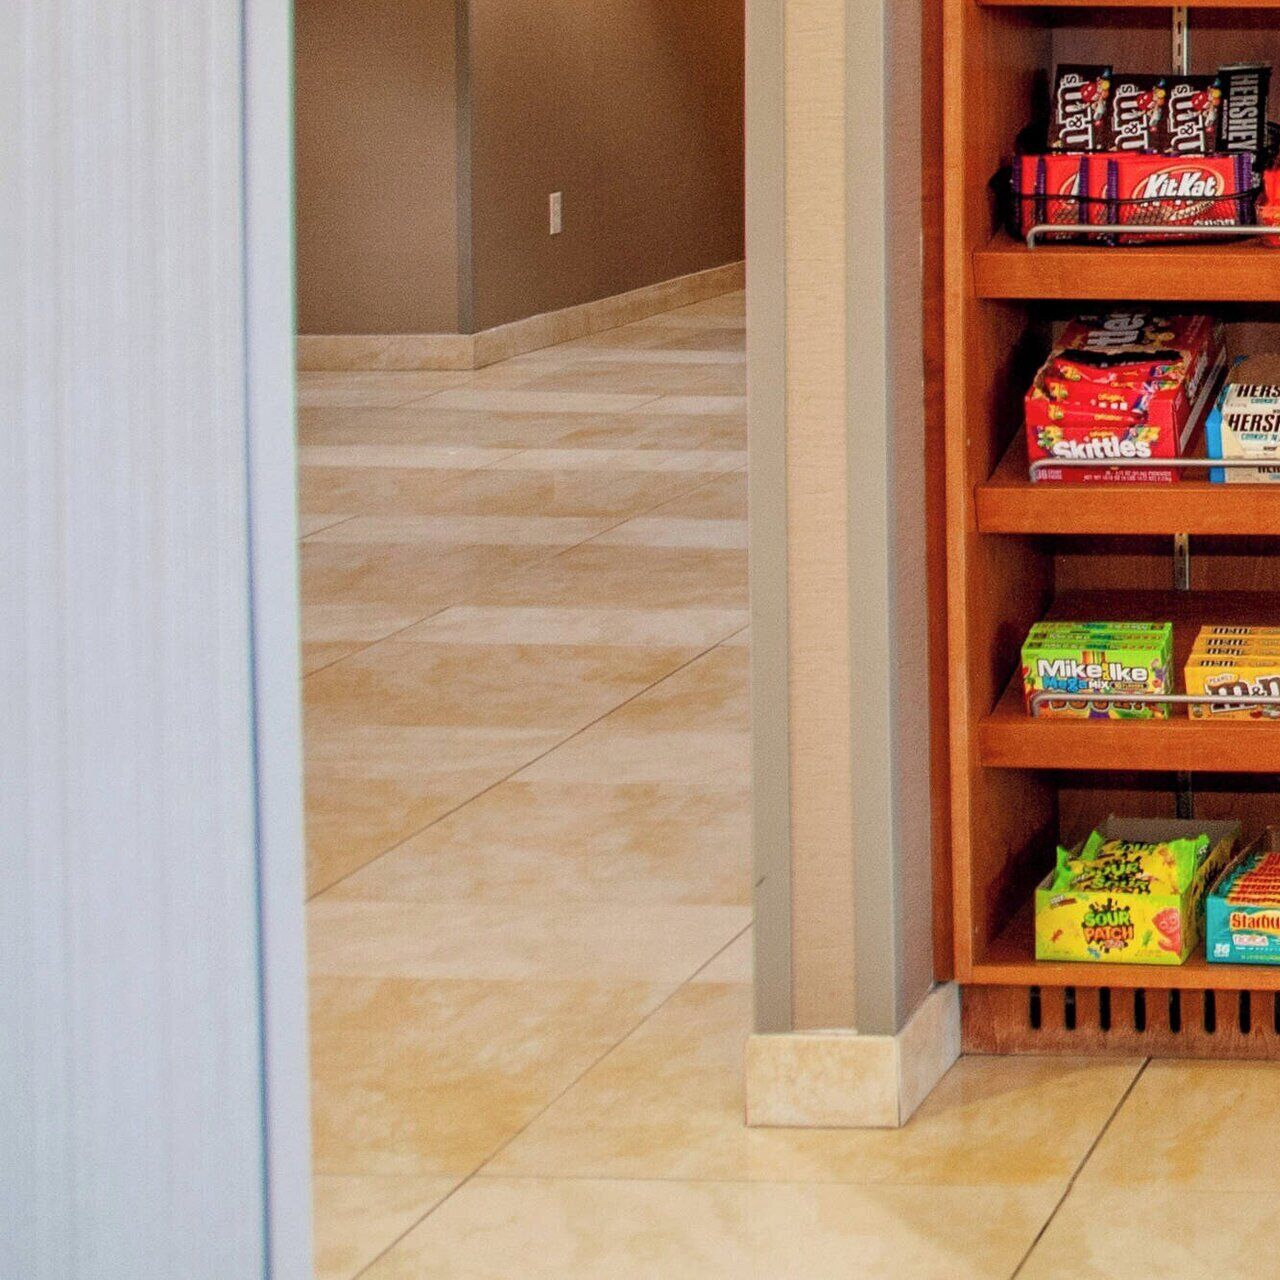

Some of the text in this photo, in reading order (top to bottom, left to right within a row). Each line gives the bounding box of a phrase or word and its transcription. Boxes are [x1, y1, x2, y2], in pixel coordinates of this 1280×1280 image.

[1051, 437, 1151, 459] Skittles
[1037, 659, 1150, 682] Mike Ike
[1083, 910, 1132, 926] SOUR
[1083, 926, 1134, 942] PATCH
